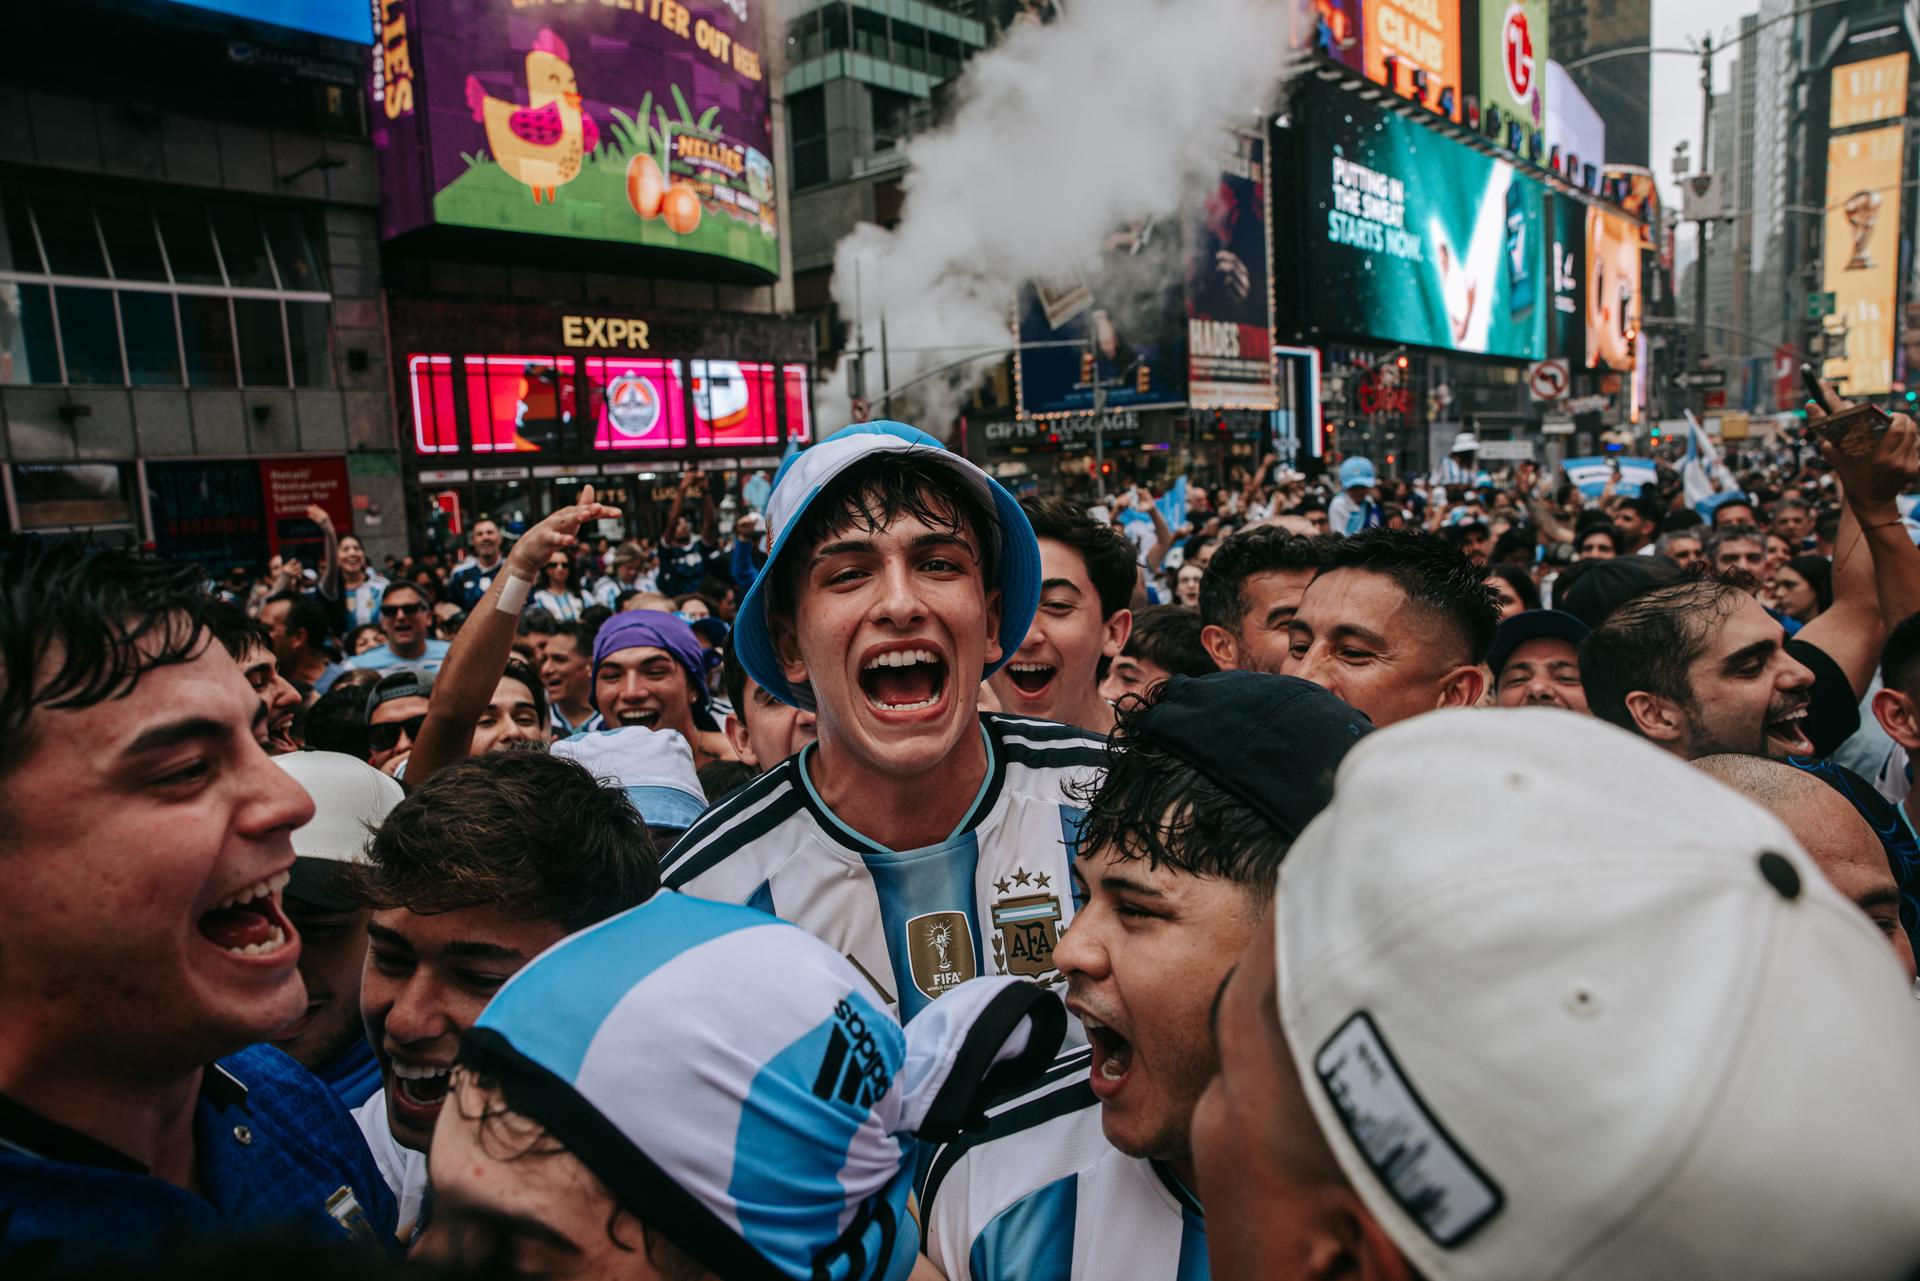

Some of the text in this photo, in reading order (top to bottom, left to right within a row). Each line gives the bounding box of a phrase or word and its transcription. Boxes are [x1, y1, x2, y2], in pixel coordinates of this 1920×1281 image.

[695, 19, 731, 64] OUT
[1377, 5, 1445, 73] CLUB
[1332, 156, 1389, 199] PUTTING
[1332, 182, 1361, 216] THE
[1328, 208, 1384, 253] STARTS
[562, 316, 650, 350] EXPR
[985, 411, 1139, 440] GIFTS LUGGAGE
[1011, 921, 1054, 962] AFA
[933, 971, 961, 986] FIFA
[834, 998, 889, 1103] adidas
